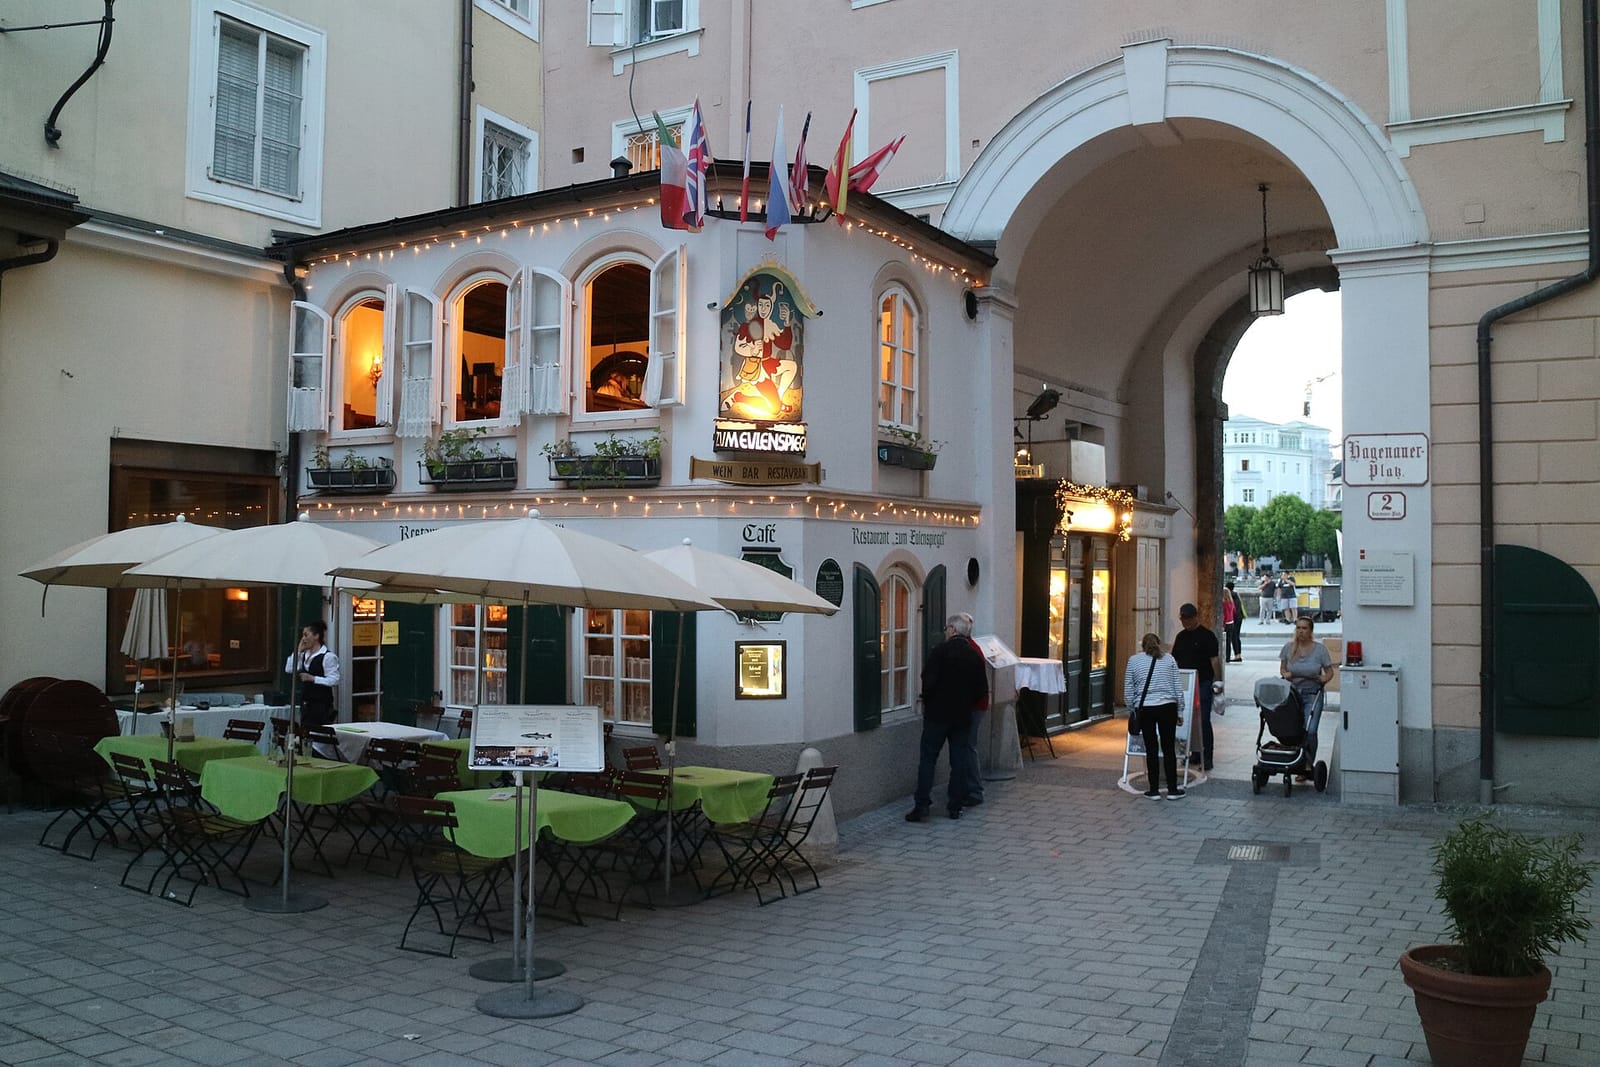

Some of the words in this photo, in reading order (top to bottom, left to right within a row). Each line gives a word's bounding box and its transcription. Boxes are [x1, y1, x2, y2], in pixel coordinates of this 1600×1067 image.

[713, 465, 733, 478] WEIN
[742, 467, 759, 479] BAR
[1381, 494, 1393, 511] 2
[742, 523, 776, 543] Café
[852, 527, 890, 545] Restaurant
